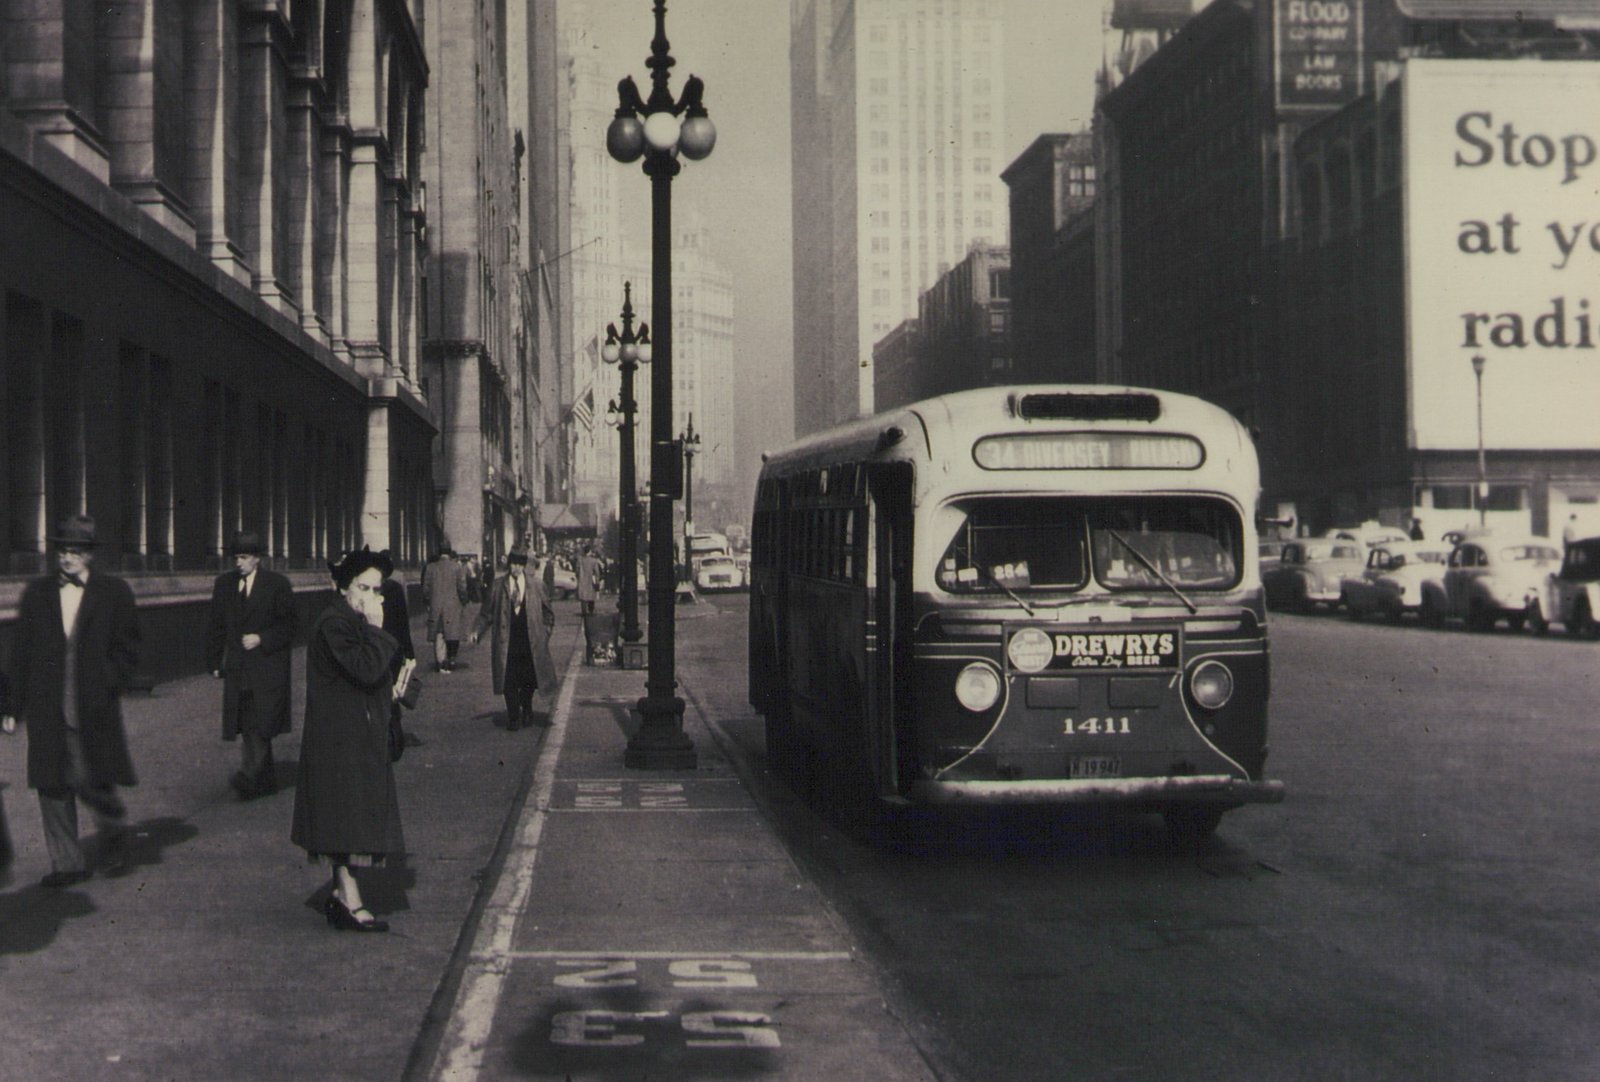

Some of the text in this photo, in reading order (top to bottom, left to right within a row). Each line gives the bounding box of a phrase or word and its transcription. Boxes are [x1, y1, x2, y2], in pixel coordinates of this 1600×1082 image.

[1288, 1, 1350, 22] FLOOD
[1304, 54, 1336, 69] LAW
[1455, 111, 1597, 185] Stop
[1458, 213, 1521, 254] at
[1024, 441, 1111, 468] DIVERSEY
[1055, 634, 1174, 656] DREWRYS
[1127, 656, 1160, 666] BEER
[1063, 717, 1131, 734] 1411
